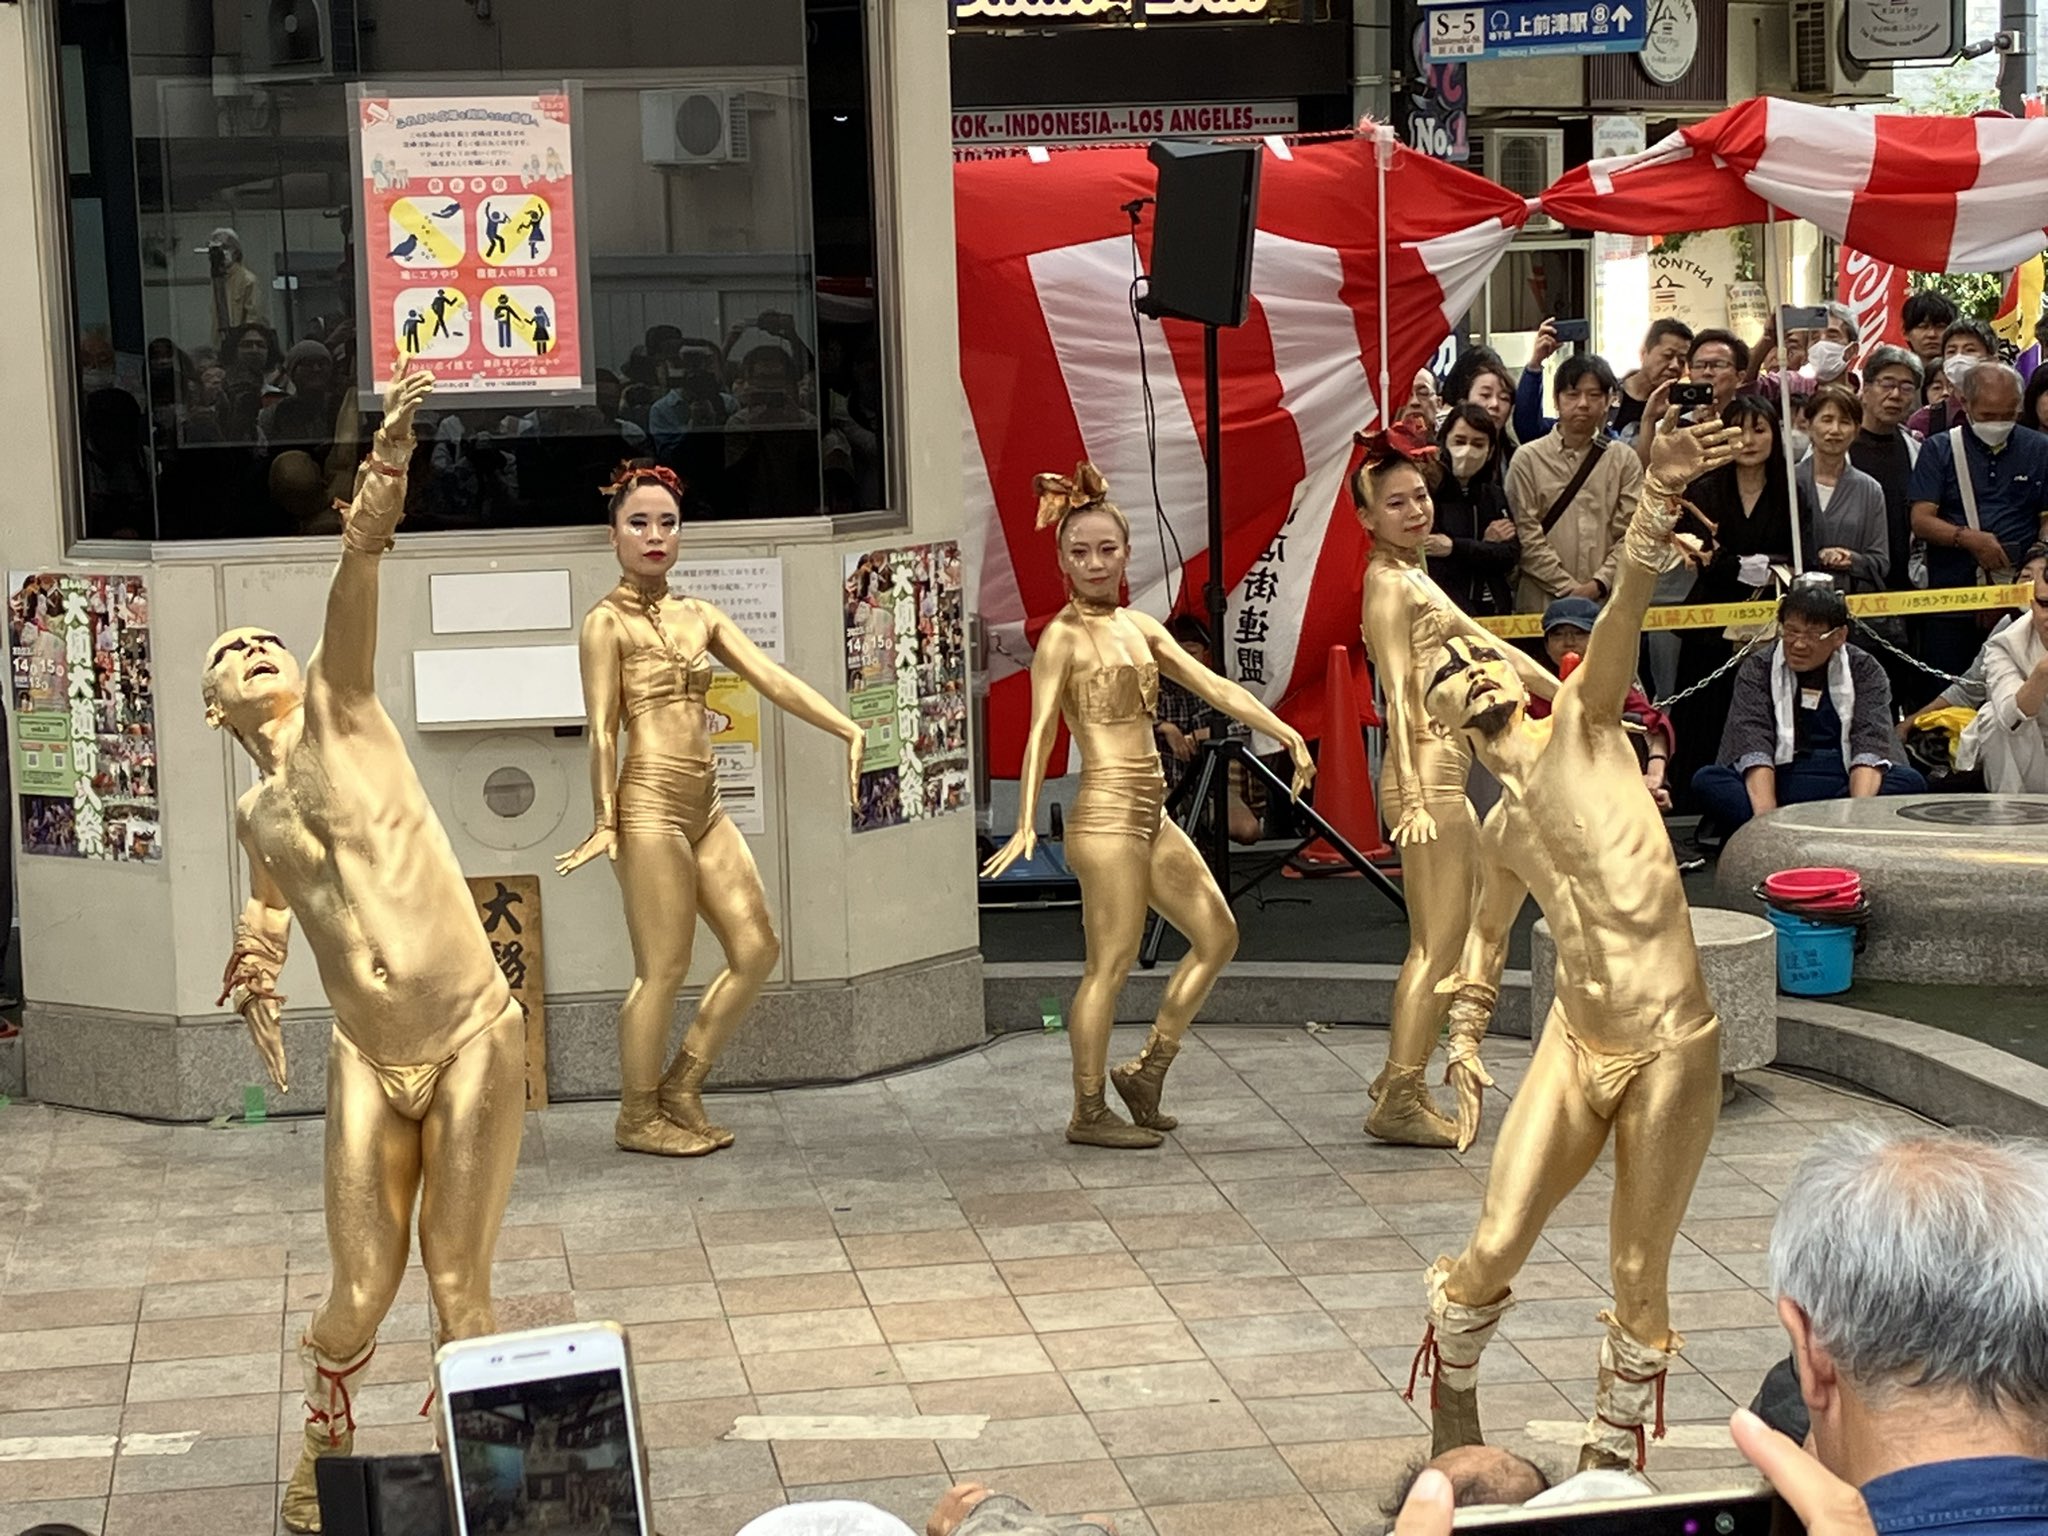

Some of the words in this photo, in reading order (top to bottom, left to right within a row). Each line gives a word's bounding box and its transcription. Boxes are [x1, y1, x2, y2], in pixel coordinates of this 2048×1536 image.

[1437, 13, 1475, 36] S-5
[1514, 12, 1588, 37] 上前津駅
[1414, 116, 1467, 157] No.1
